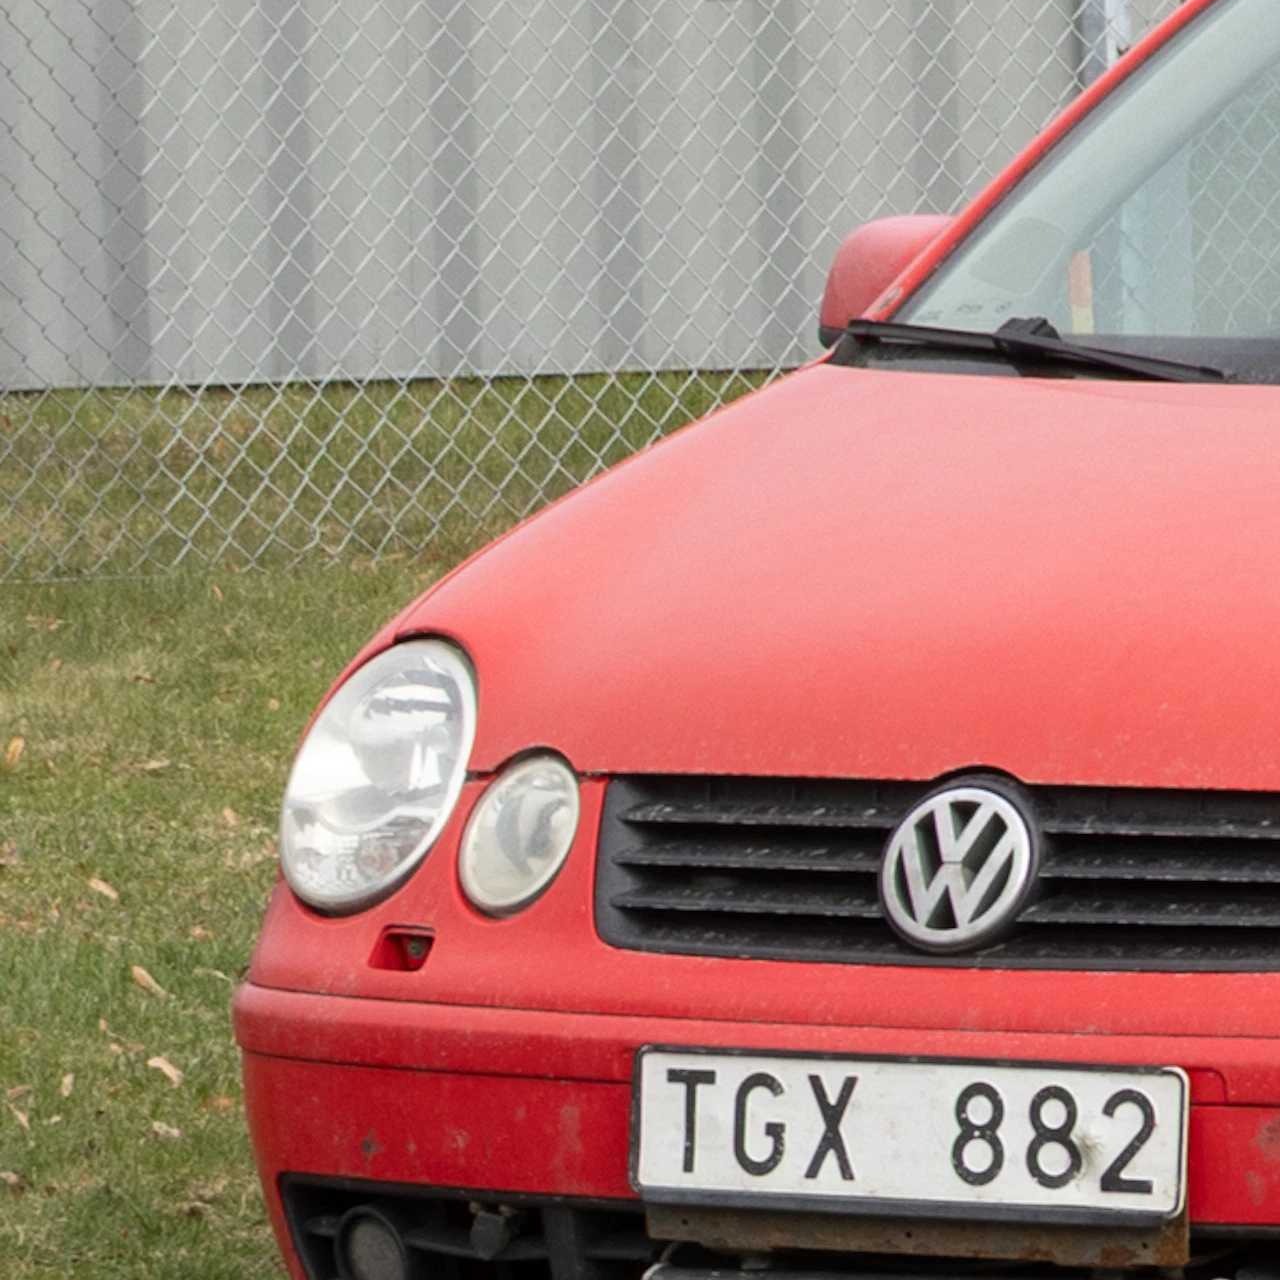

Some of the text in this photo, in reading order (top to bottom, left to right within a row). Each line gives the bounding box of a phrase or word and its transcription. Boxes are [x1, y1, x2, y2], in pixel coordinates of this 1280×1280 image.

[883, 787, 1030, 943] VW
[666, 1068, 1157, 1195] TGX 882
